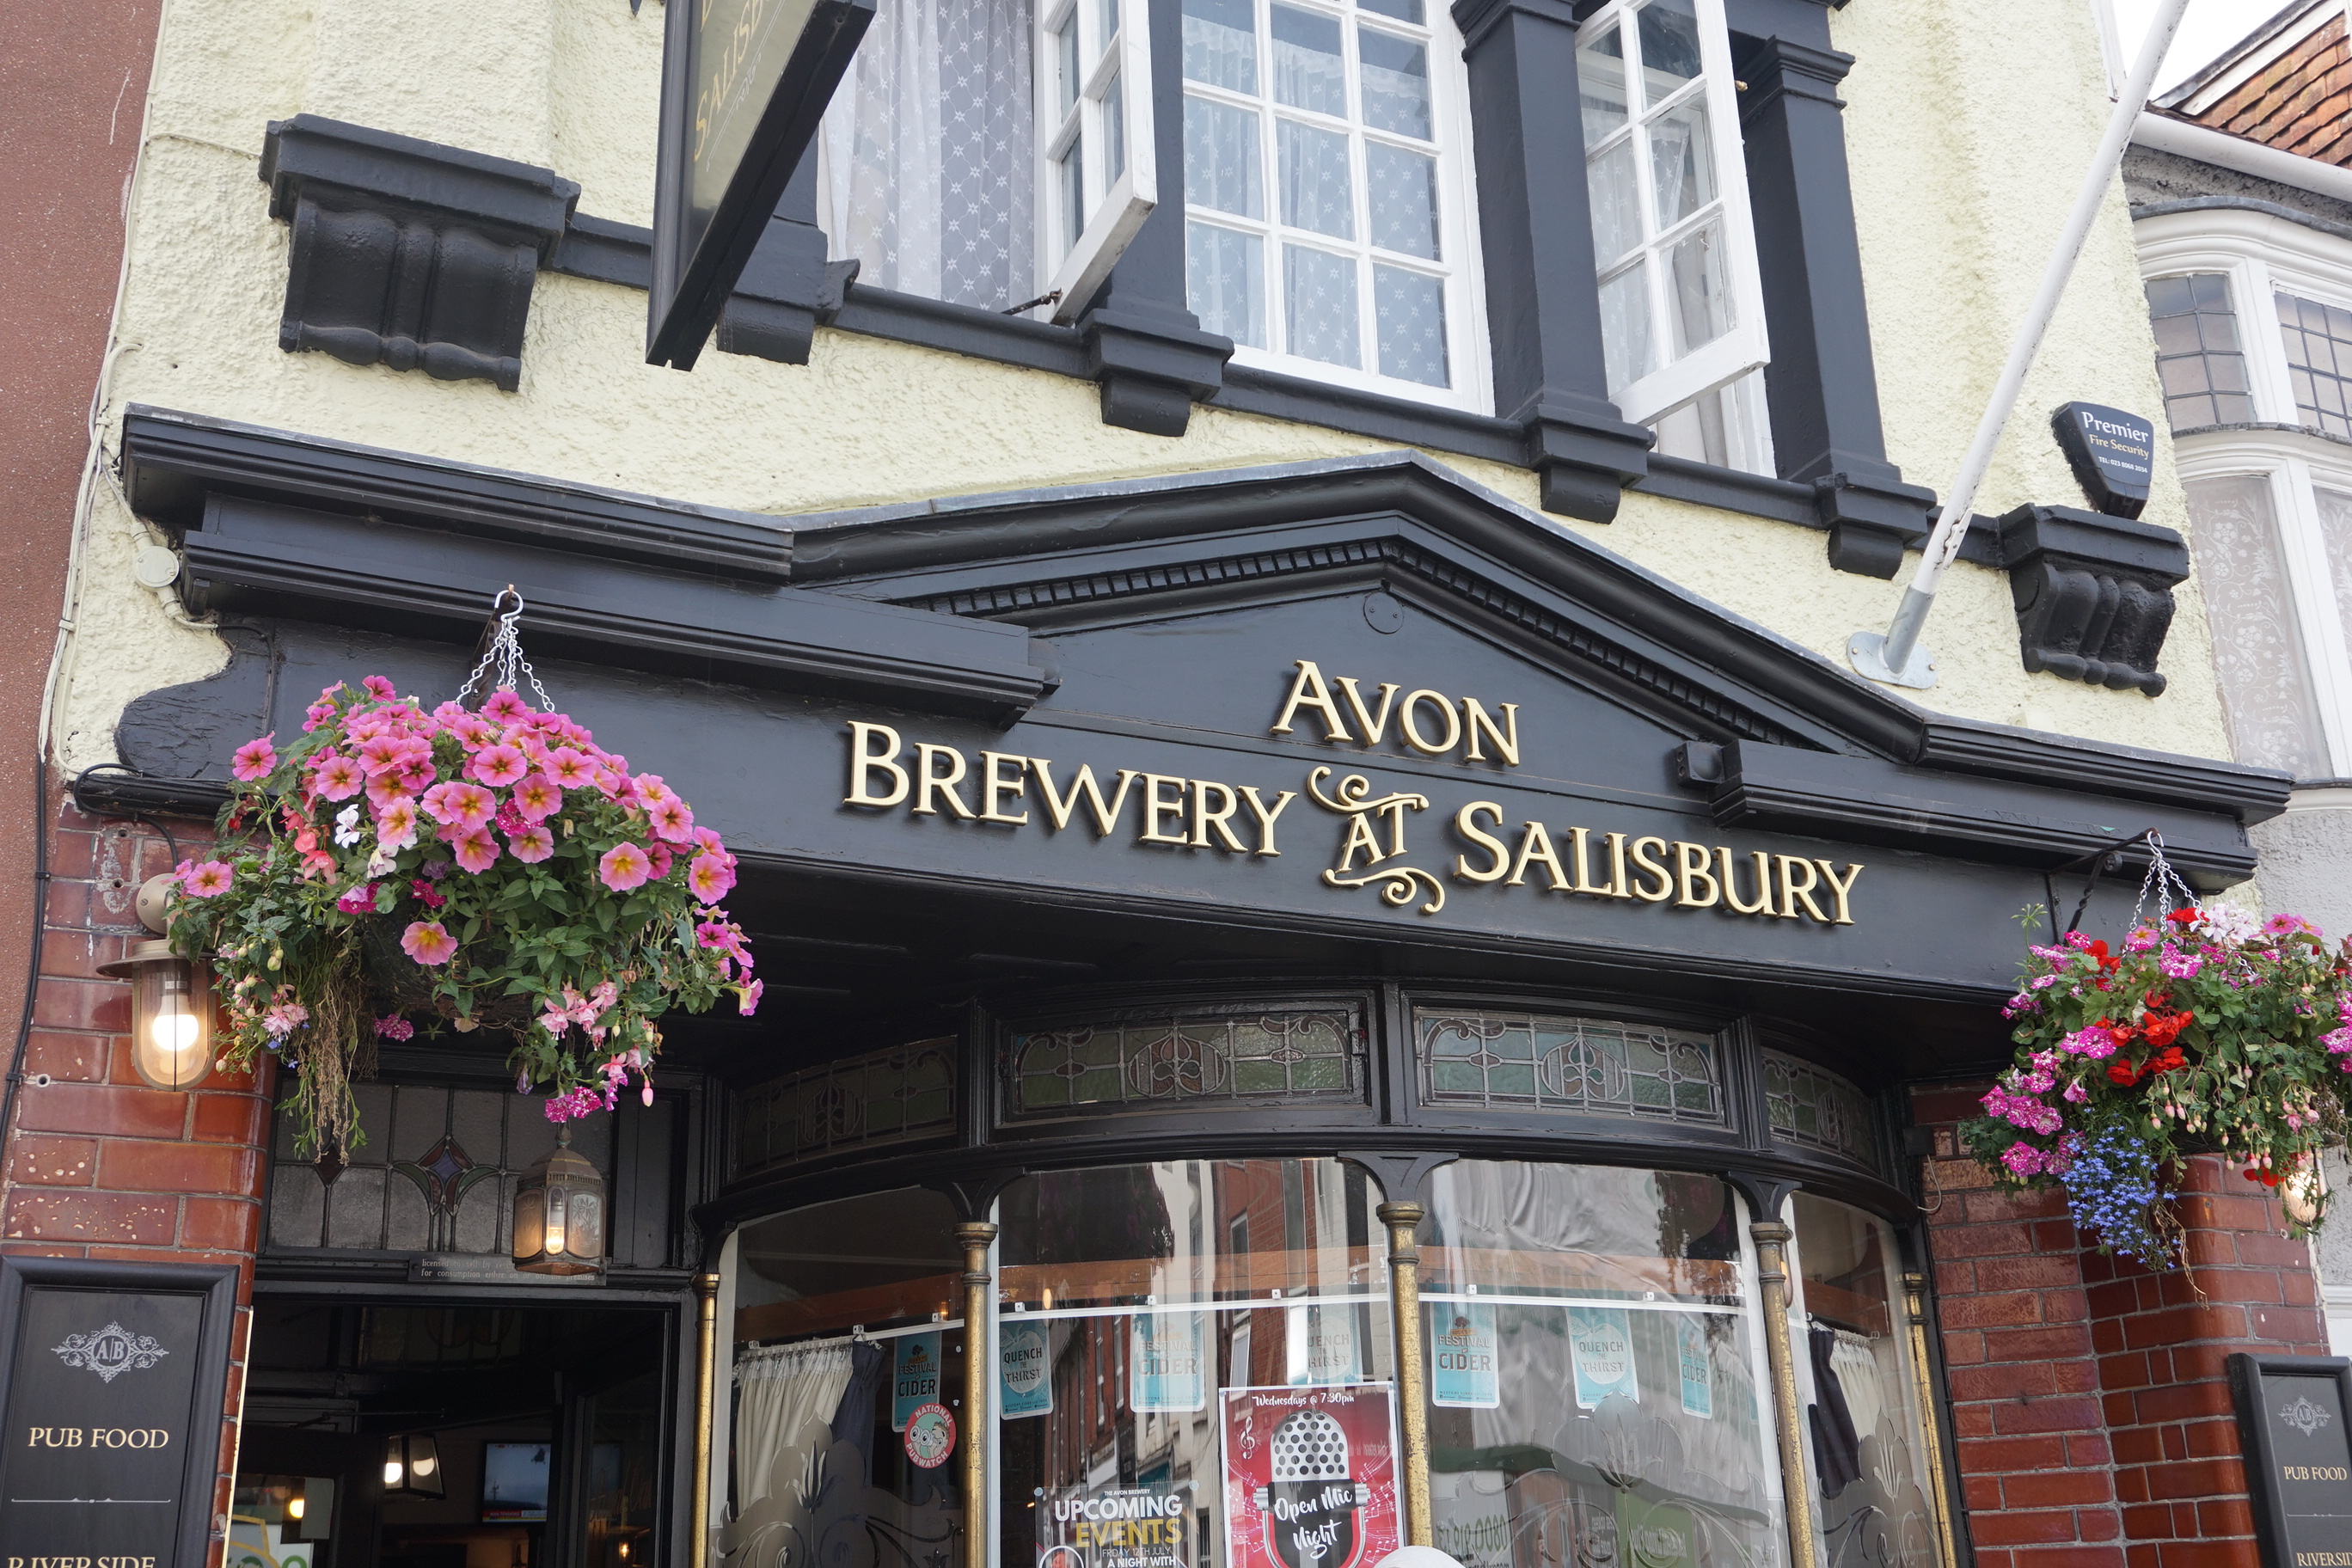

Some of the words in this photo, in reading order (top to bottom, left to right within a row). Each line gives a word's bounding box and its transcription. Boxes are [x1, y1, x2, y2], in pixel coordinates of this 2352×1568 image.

[2081, 411, 2148, 443] Premier
[2088, 433, 2109, 447] Fire
[2110, 438, 2149, 460] Security
[1269, 658, 1520, 768] AVON
[842, 720, 1298, 857] BREWERY
[1334, 798, 1420, 874] AT
[1453, 800, 1865, 926] SALISBURY
[422, 1259, 449, 1267] licensed
[467, 1259, 478, 1268] sell
[482, 1259, 490, 1270] by
[421, 1268, 432, 1277] for
[438, 1270, 480, 1279] consumption
[1138, 1341, 1197, 1352] FESTIVAL
[1307, 1334, 1350, 1348] UENCH
[1438, 1334, 1491, 1347] FESTIVAL
[1579, 1341, 1624, 1354] QUENCH
[1004, 1347, 1042, 1364] QUENCH
[1308, 1356, 1350, 1368] HIRST
[1438, 1353, 1491, 1371] CIDER
[899, 1362, 936, 1375] FESTIVAL
[1138, 1358, 1197, 1376] CIDER
[1583, 1362, 1625, 1373] THIRST
[1682, 1364, 1707, 1384] CIDER
[1006, 1369, 1042, 1383] THIRST
[898, 1379, 936, 1398] CIDER
[1252, 1393, 1307, 1407] Wednesdays
[1309, 1395, 1318, 1405] @
[1320, 1392, 1355, 1406] 7:30pm
[915, 1405, 954, 1427] NATIONAL
[28, 1427, 83, 1448] PUB
[90, 1428, 169, 1449] FOOD
[906, 1442, 949, 1468] PUBWATCH
[2283, 1466, 2310, 1480] PUB
[2312, 1467, 2348, 1480] FOOD
[1055, 1495, 1183, 1522] UPCOMING
[1274, 1498, 1318, 1524] Open
[1320, 1486, 1352, 1510] Mic
[1075, 1518, 1182, 1547] EVENTS
[1293, 1519, 1342, 1559] Night
[1102, 1548, 1130, 1558] FRIDAY
[1151, 1547, 1172, 1555] JULY
[1107, 1559, 1116, 1568] A
[1118, 1558, 1148, 1568] NIGHT
[1150, 1556, 1177, 1566] WITH
